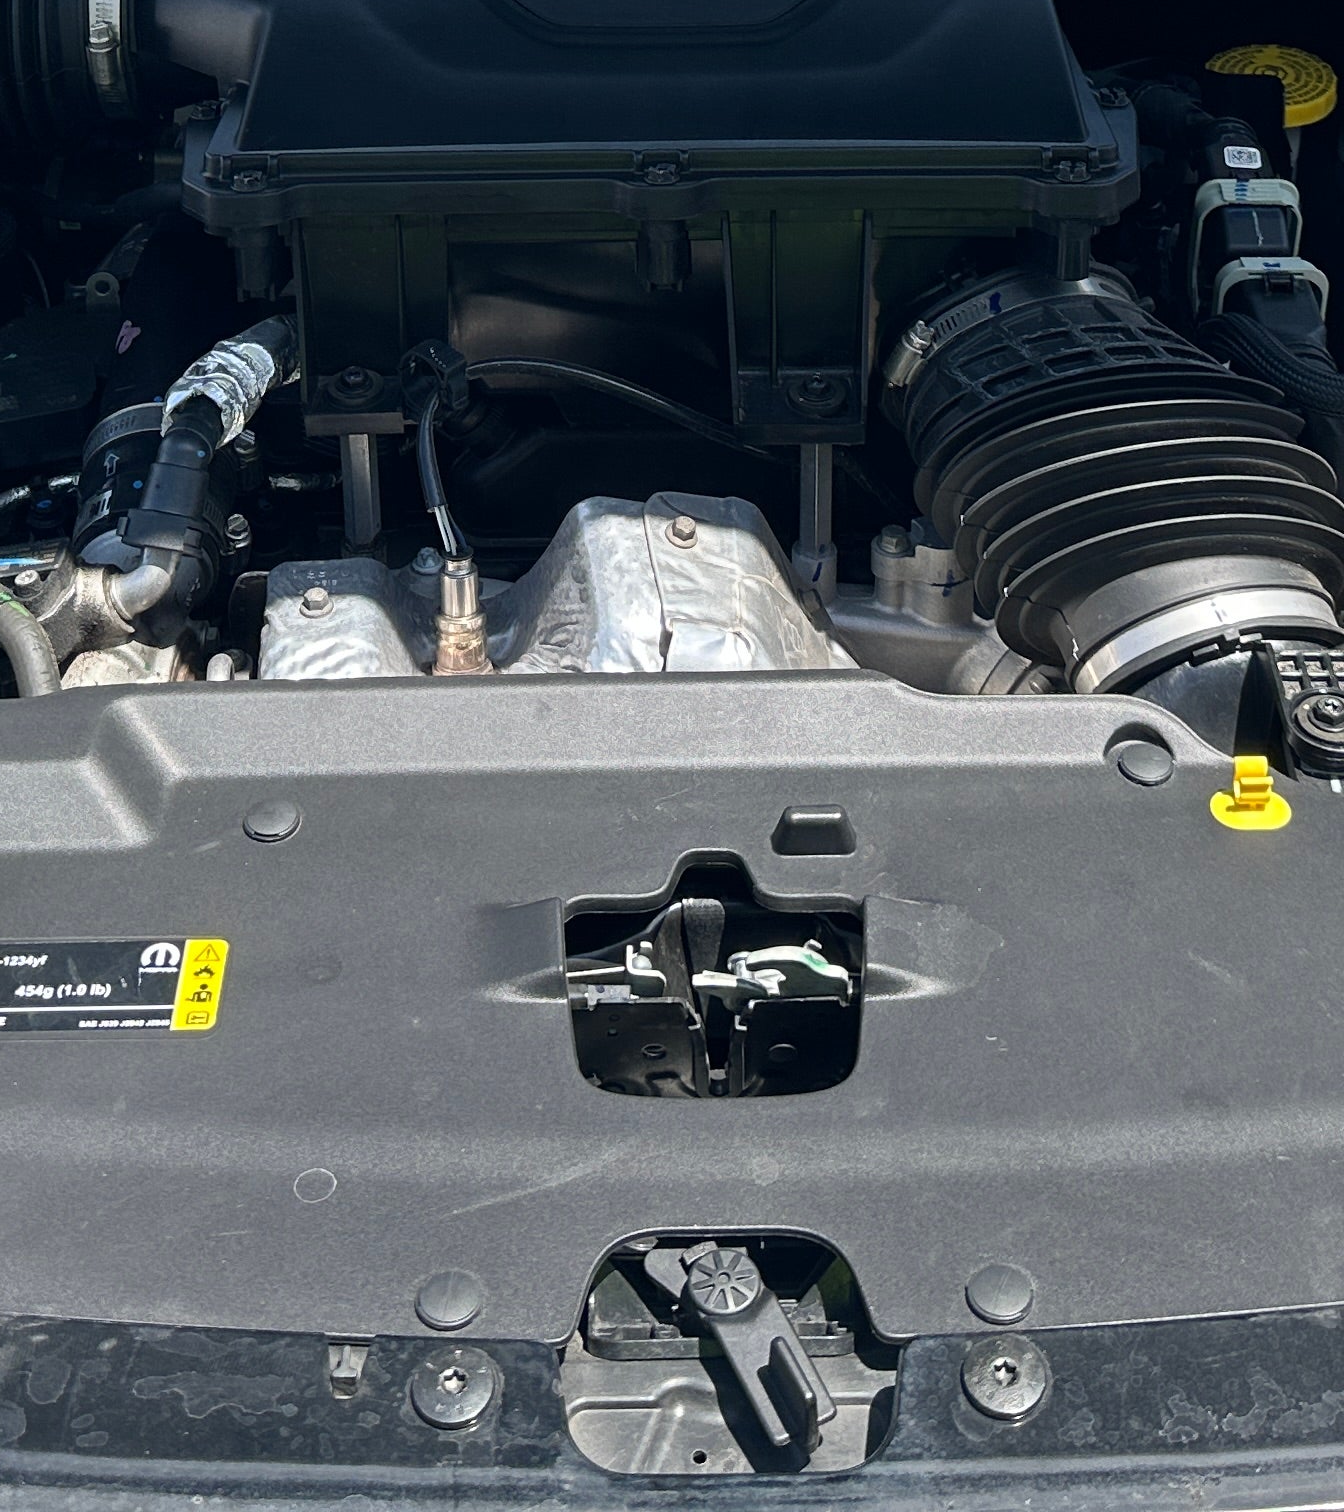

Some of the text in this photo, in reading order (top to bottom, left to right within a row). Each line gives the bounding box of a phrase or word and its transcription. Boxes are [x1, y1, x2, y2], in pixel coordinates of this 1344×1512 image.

[14, 983, 112, 1000] 454g (1.0 lb)
